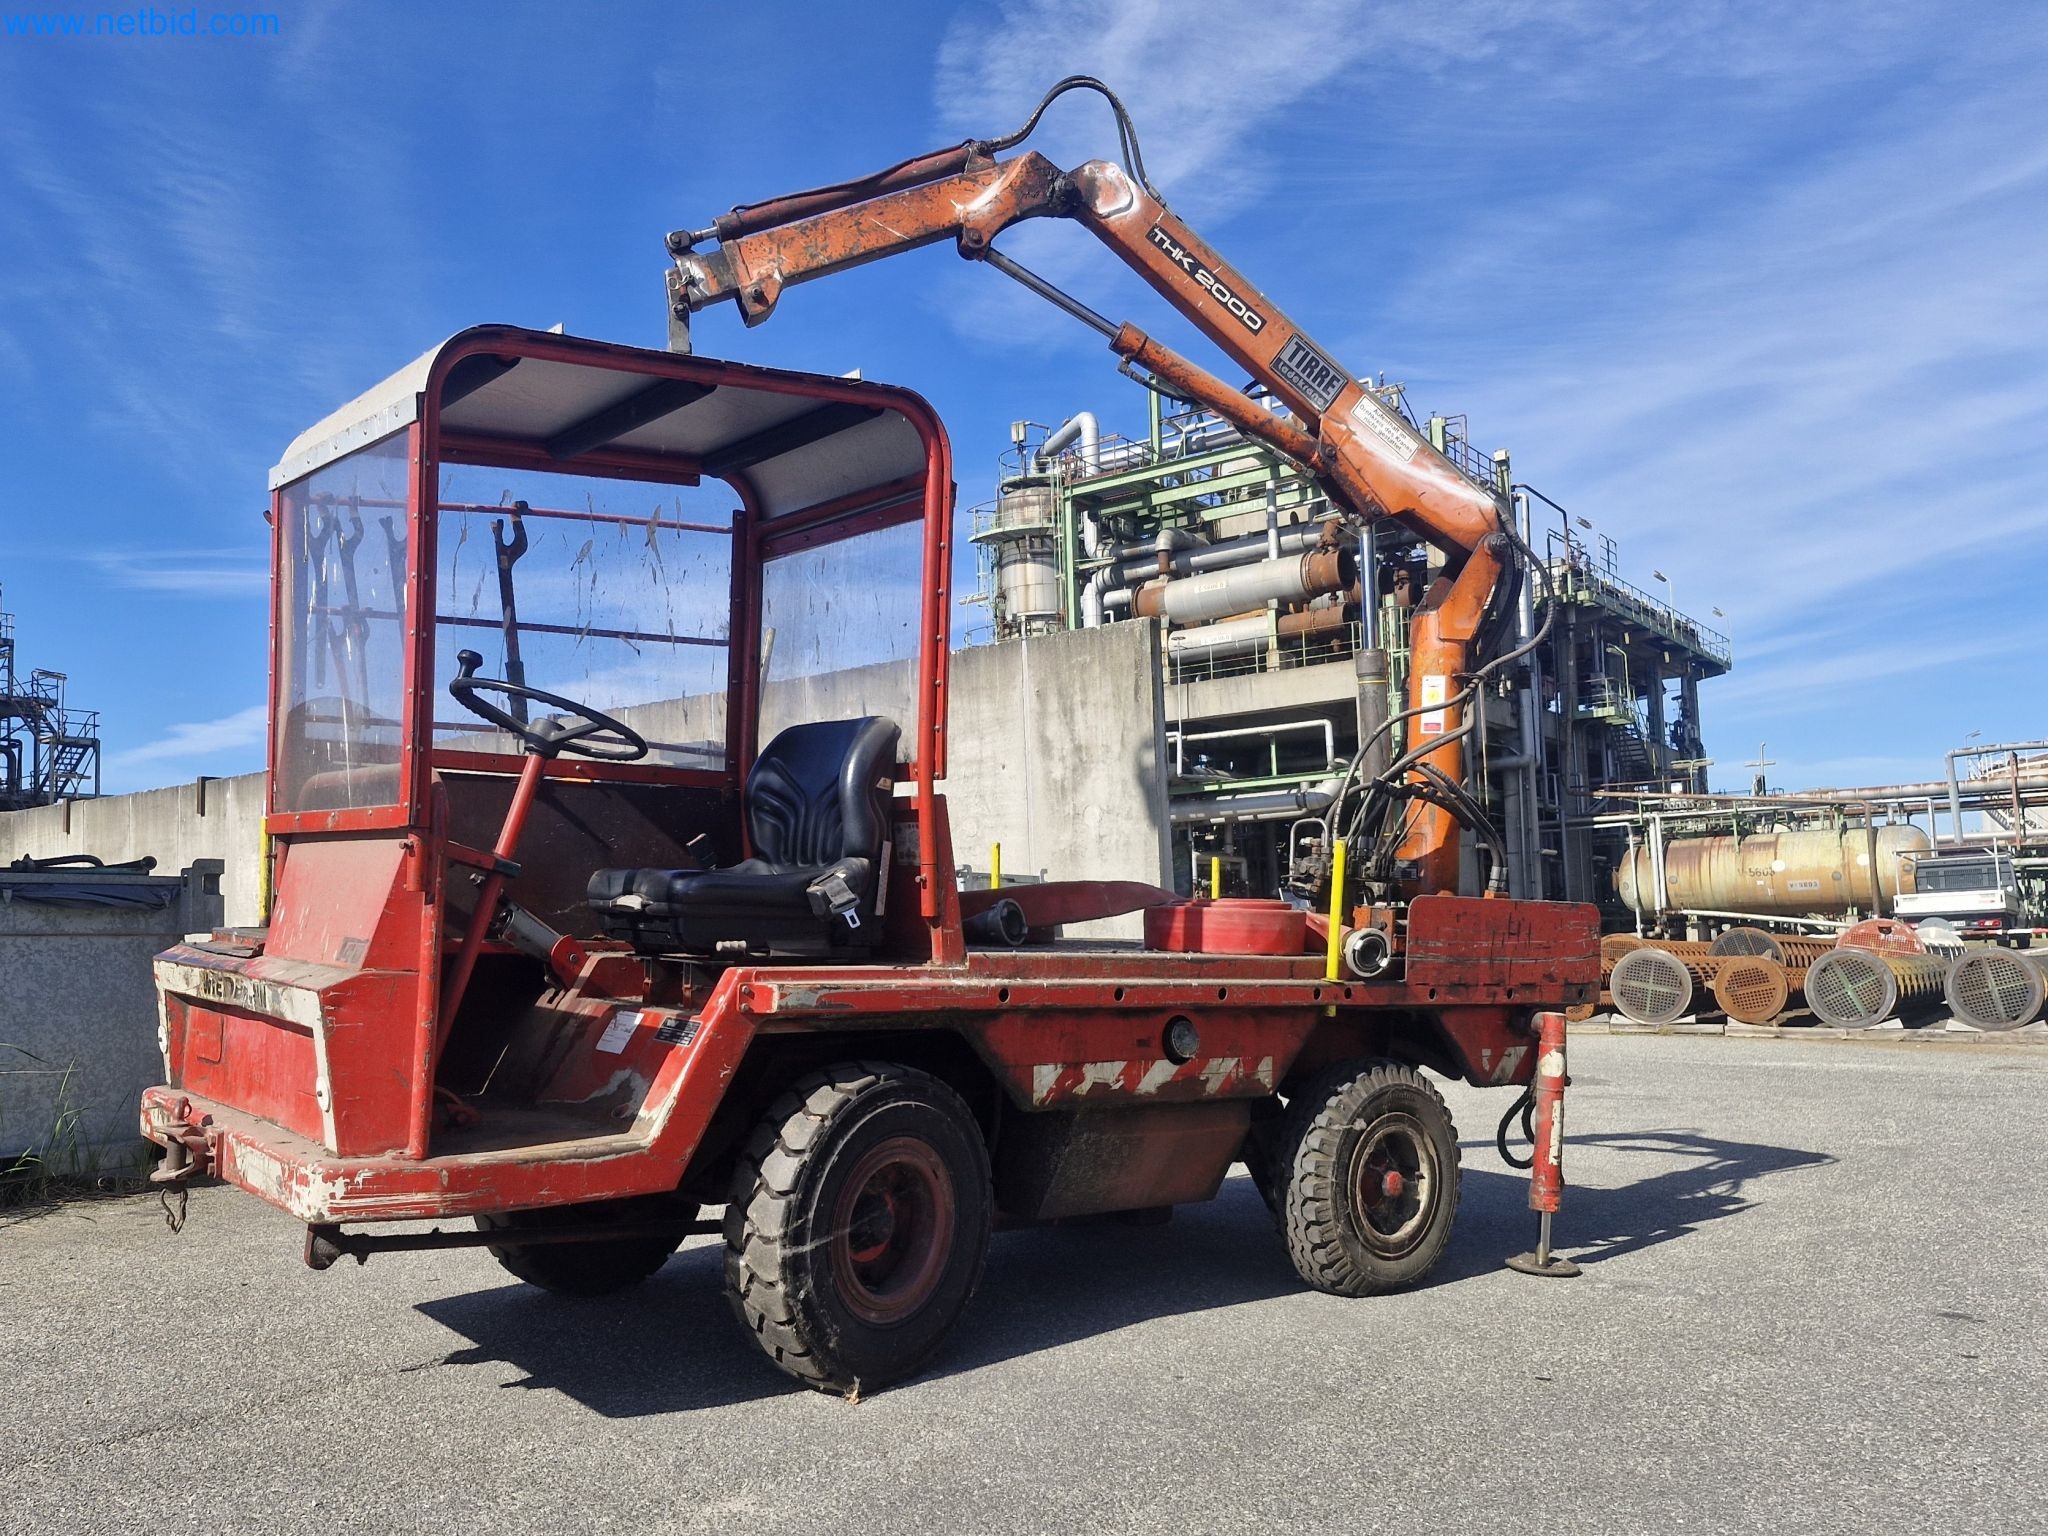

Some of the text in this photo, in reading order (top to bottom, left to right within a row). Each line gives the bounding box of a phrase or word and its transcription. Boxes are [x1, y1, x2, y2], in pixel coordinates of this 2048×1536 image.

[1154, 227, 1262, 330] THK 2000
[1288, 341, 1341, 396] TIRRE
